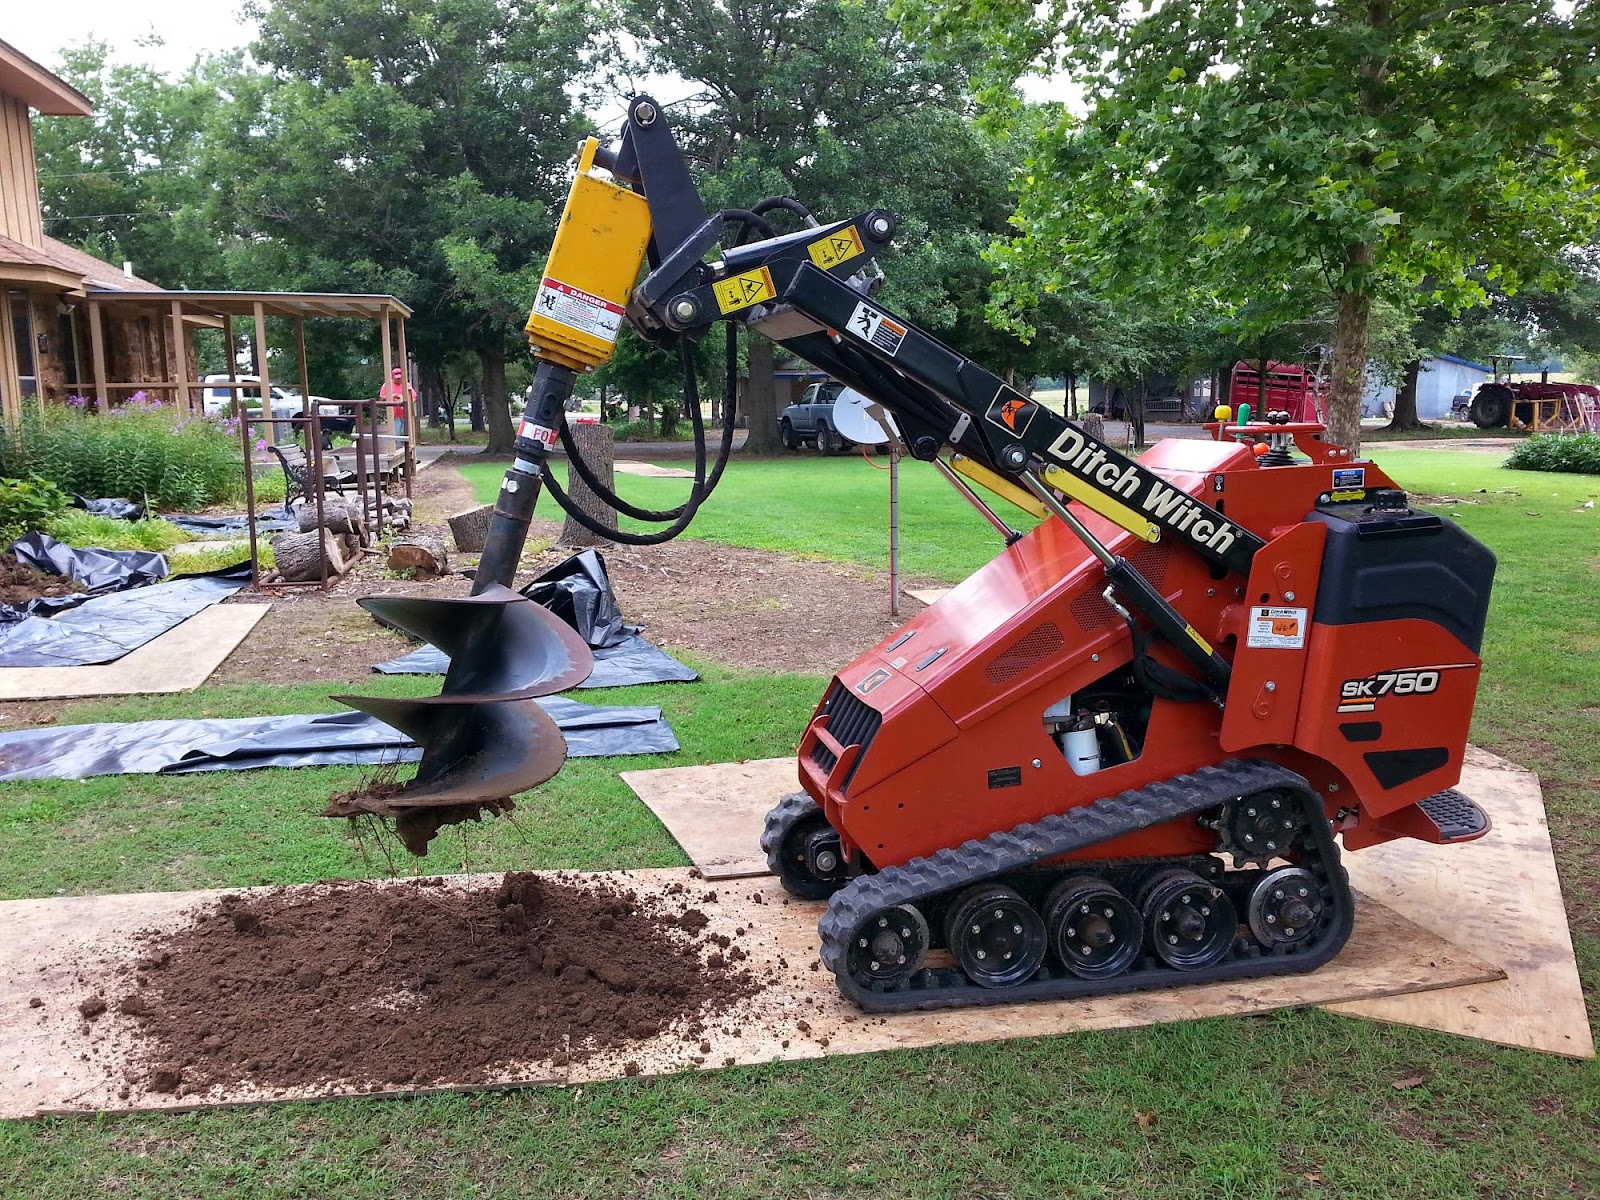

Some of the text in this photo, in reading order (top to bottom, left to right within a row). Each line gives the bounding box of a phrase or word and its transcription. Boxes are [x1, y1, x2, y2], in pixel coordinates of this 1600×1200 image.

[570, 289, 608, 309] DANGER
[1047, 427, 1235, 555] Ditch Witch
[1342, 672, 1439, 697] SK750
